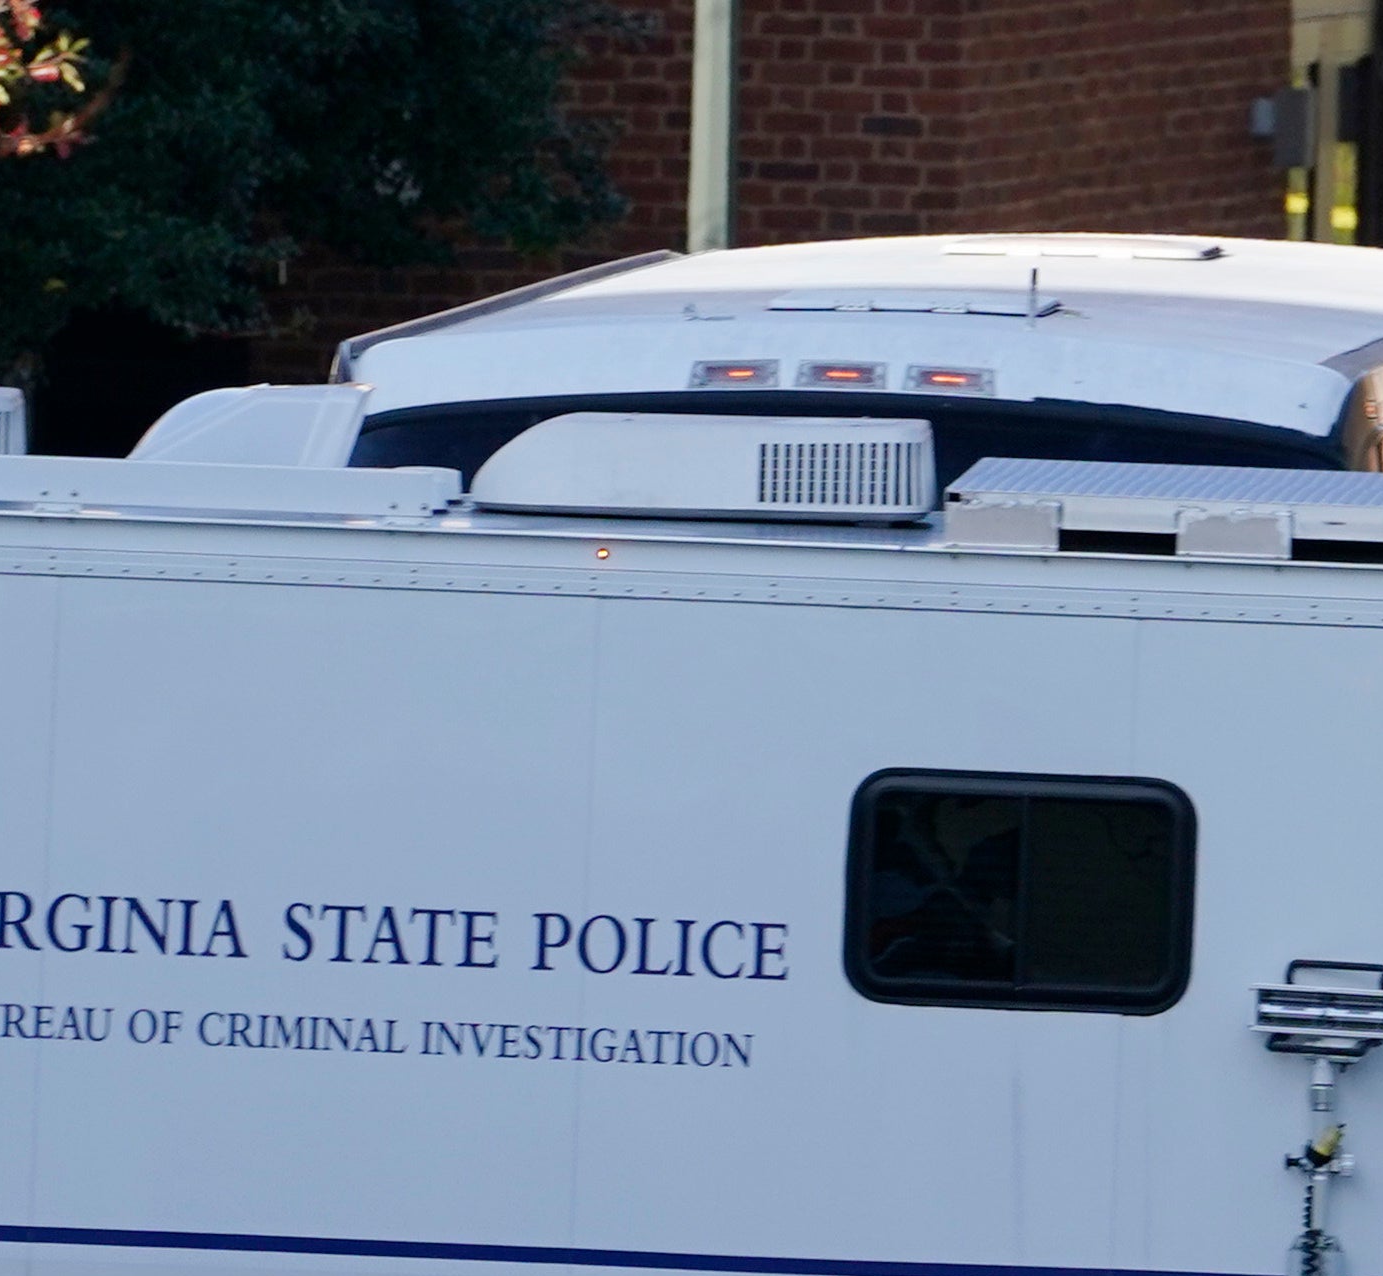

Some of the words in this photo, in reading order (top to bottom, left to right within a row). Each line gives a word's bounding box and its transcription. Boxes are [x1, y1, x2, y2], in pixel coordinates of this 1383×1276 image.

[281, 901, 501, 969] STATE
[530, 912, 791, 981] POLICE
[127, 1008, 183, 1045] OF
[197, 1010, 409, 1055] CRIMINAL
[419, 1020, 755, 1068] INVESTIGATION
